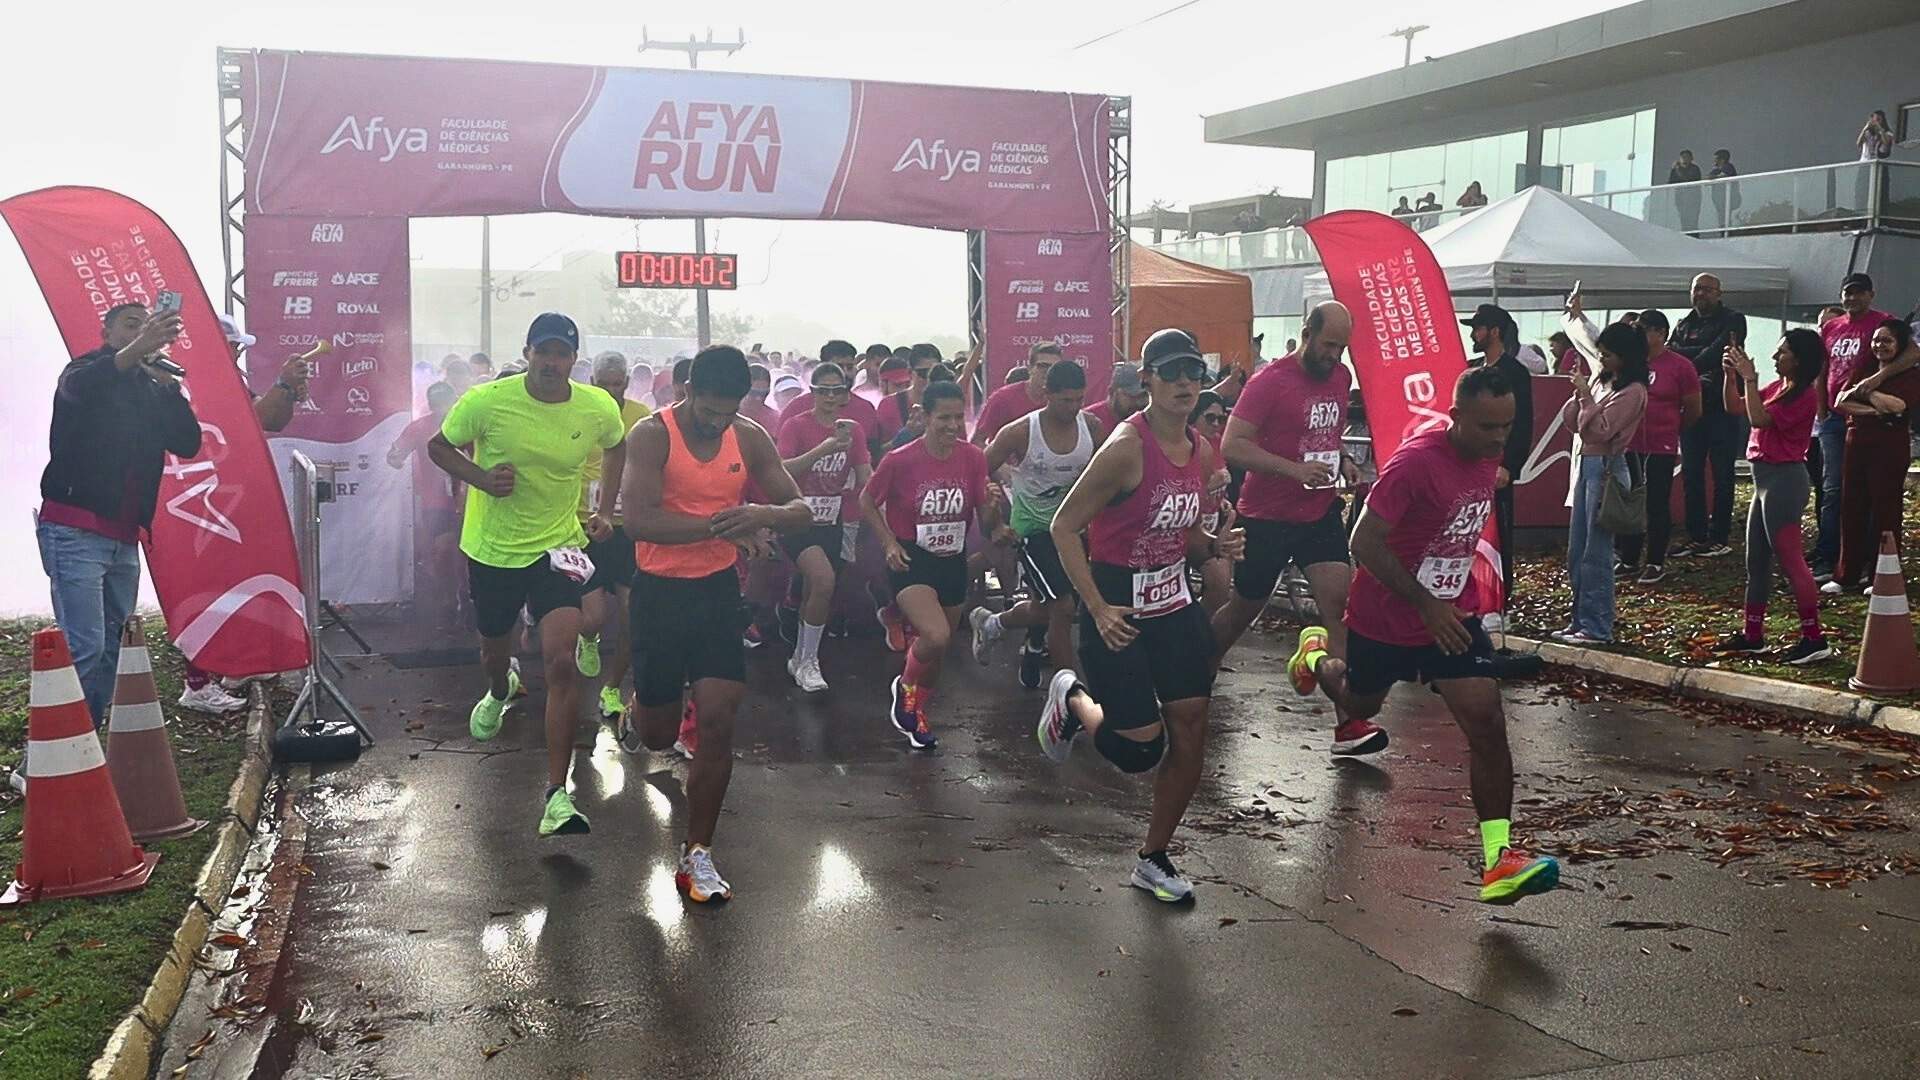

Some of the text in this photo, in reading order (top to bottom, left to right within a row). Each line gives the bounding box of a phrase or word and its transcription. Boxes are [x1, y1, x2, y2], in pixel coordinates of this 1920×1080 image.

[441, 118, 508, 129] FACULDADE
[641, 100, 781, 144] AFYA
[320, 115, 428, 162] Afya
[440, 130, 510, 142] DE CIÊNCIAS
[438, 141, 490, 154] MÉDICAS
[992, 142, 1048, 153] FACULDADE
[892, 138, 981, 181] Afya
[991, 152, 1049, 164] DE CIÊNCIAS
[633, 140, 782, 193] RUN
[989, 163, 1032, 175] MÉDICAS
[313, 223, 343, 232] AFYA
[311, 231, 343, 242] RUN
[1038, 246, 1062, 256] RUN
[621, 253, 733, 286] 00:00:02
[284, 296, 313, 315] HB
[1016, 302, 1039, 318] HB
[1358, 268, 1394, 360] FACULDADE
[280, 335, 319, 346] SOUZA
[1394, 336, 1410, 358] DE
[1311, 401, 1339, 414] AFYA
[1309, 411, 1339, 429] RUN
[924, 488, 963, 501] AFYA
[1161, 492, 1199, 511] AFYA
[920, 498, 963, 516] RUN
[1151, 507, 1199, 529] RUN
[928, 534, 954, 546] 288
[1432, 574, 1462, 589] 345
[1150, 579, 1178, 601] 096
